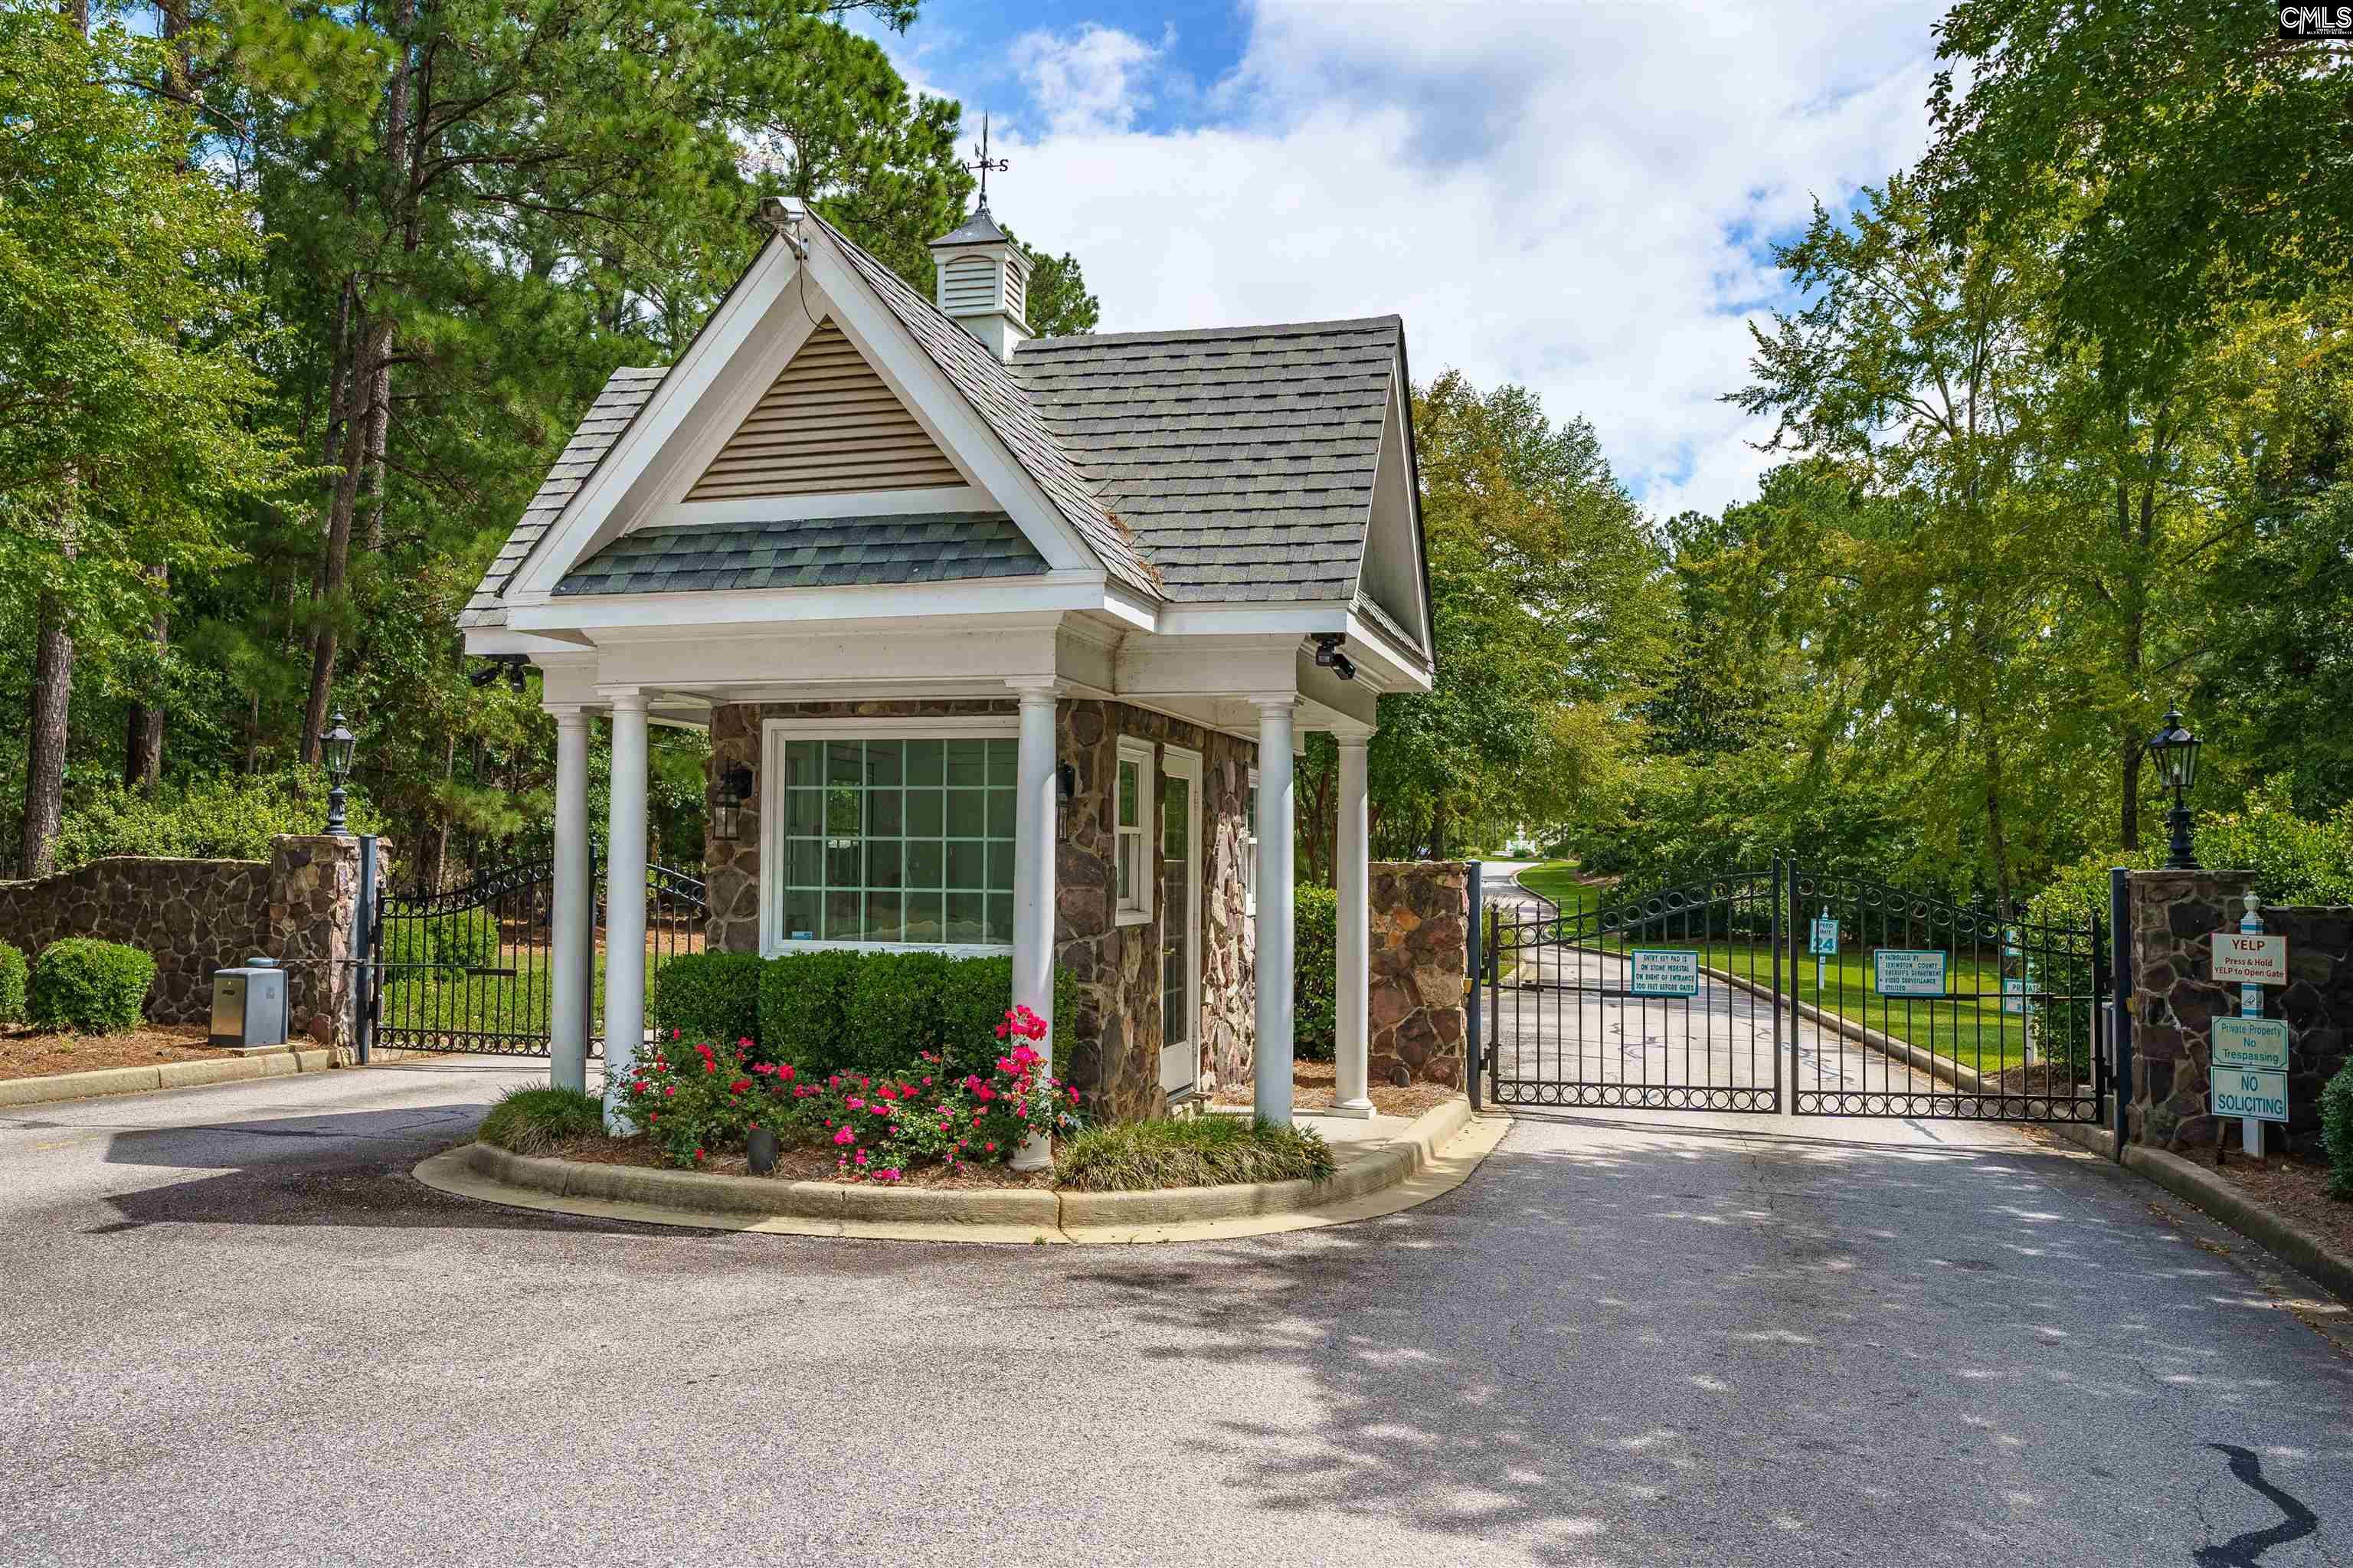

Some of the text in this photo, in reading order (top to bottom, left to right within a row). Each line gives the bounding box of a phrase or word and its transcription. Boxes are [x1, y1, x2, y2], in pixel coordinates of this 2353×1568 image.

[2232, 939, 2265, 951] YELP
[2244, 968, 2264, 977] Open
[2222, 1023, 2282, 1038] Private Property
[2243, 1038, 2256, 1048] No
[2223, 1049, 2279, 1065] Trespassing
[2241, 1075, 2258, 1092] NO
[2217, 1094, 2283, 1115] SOLICITING
